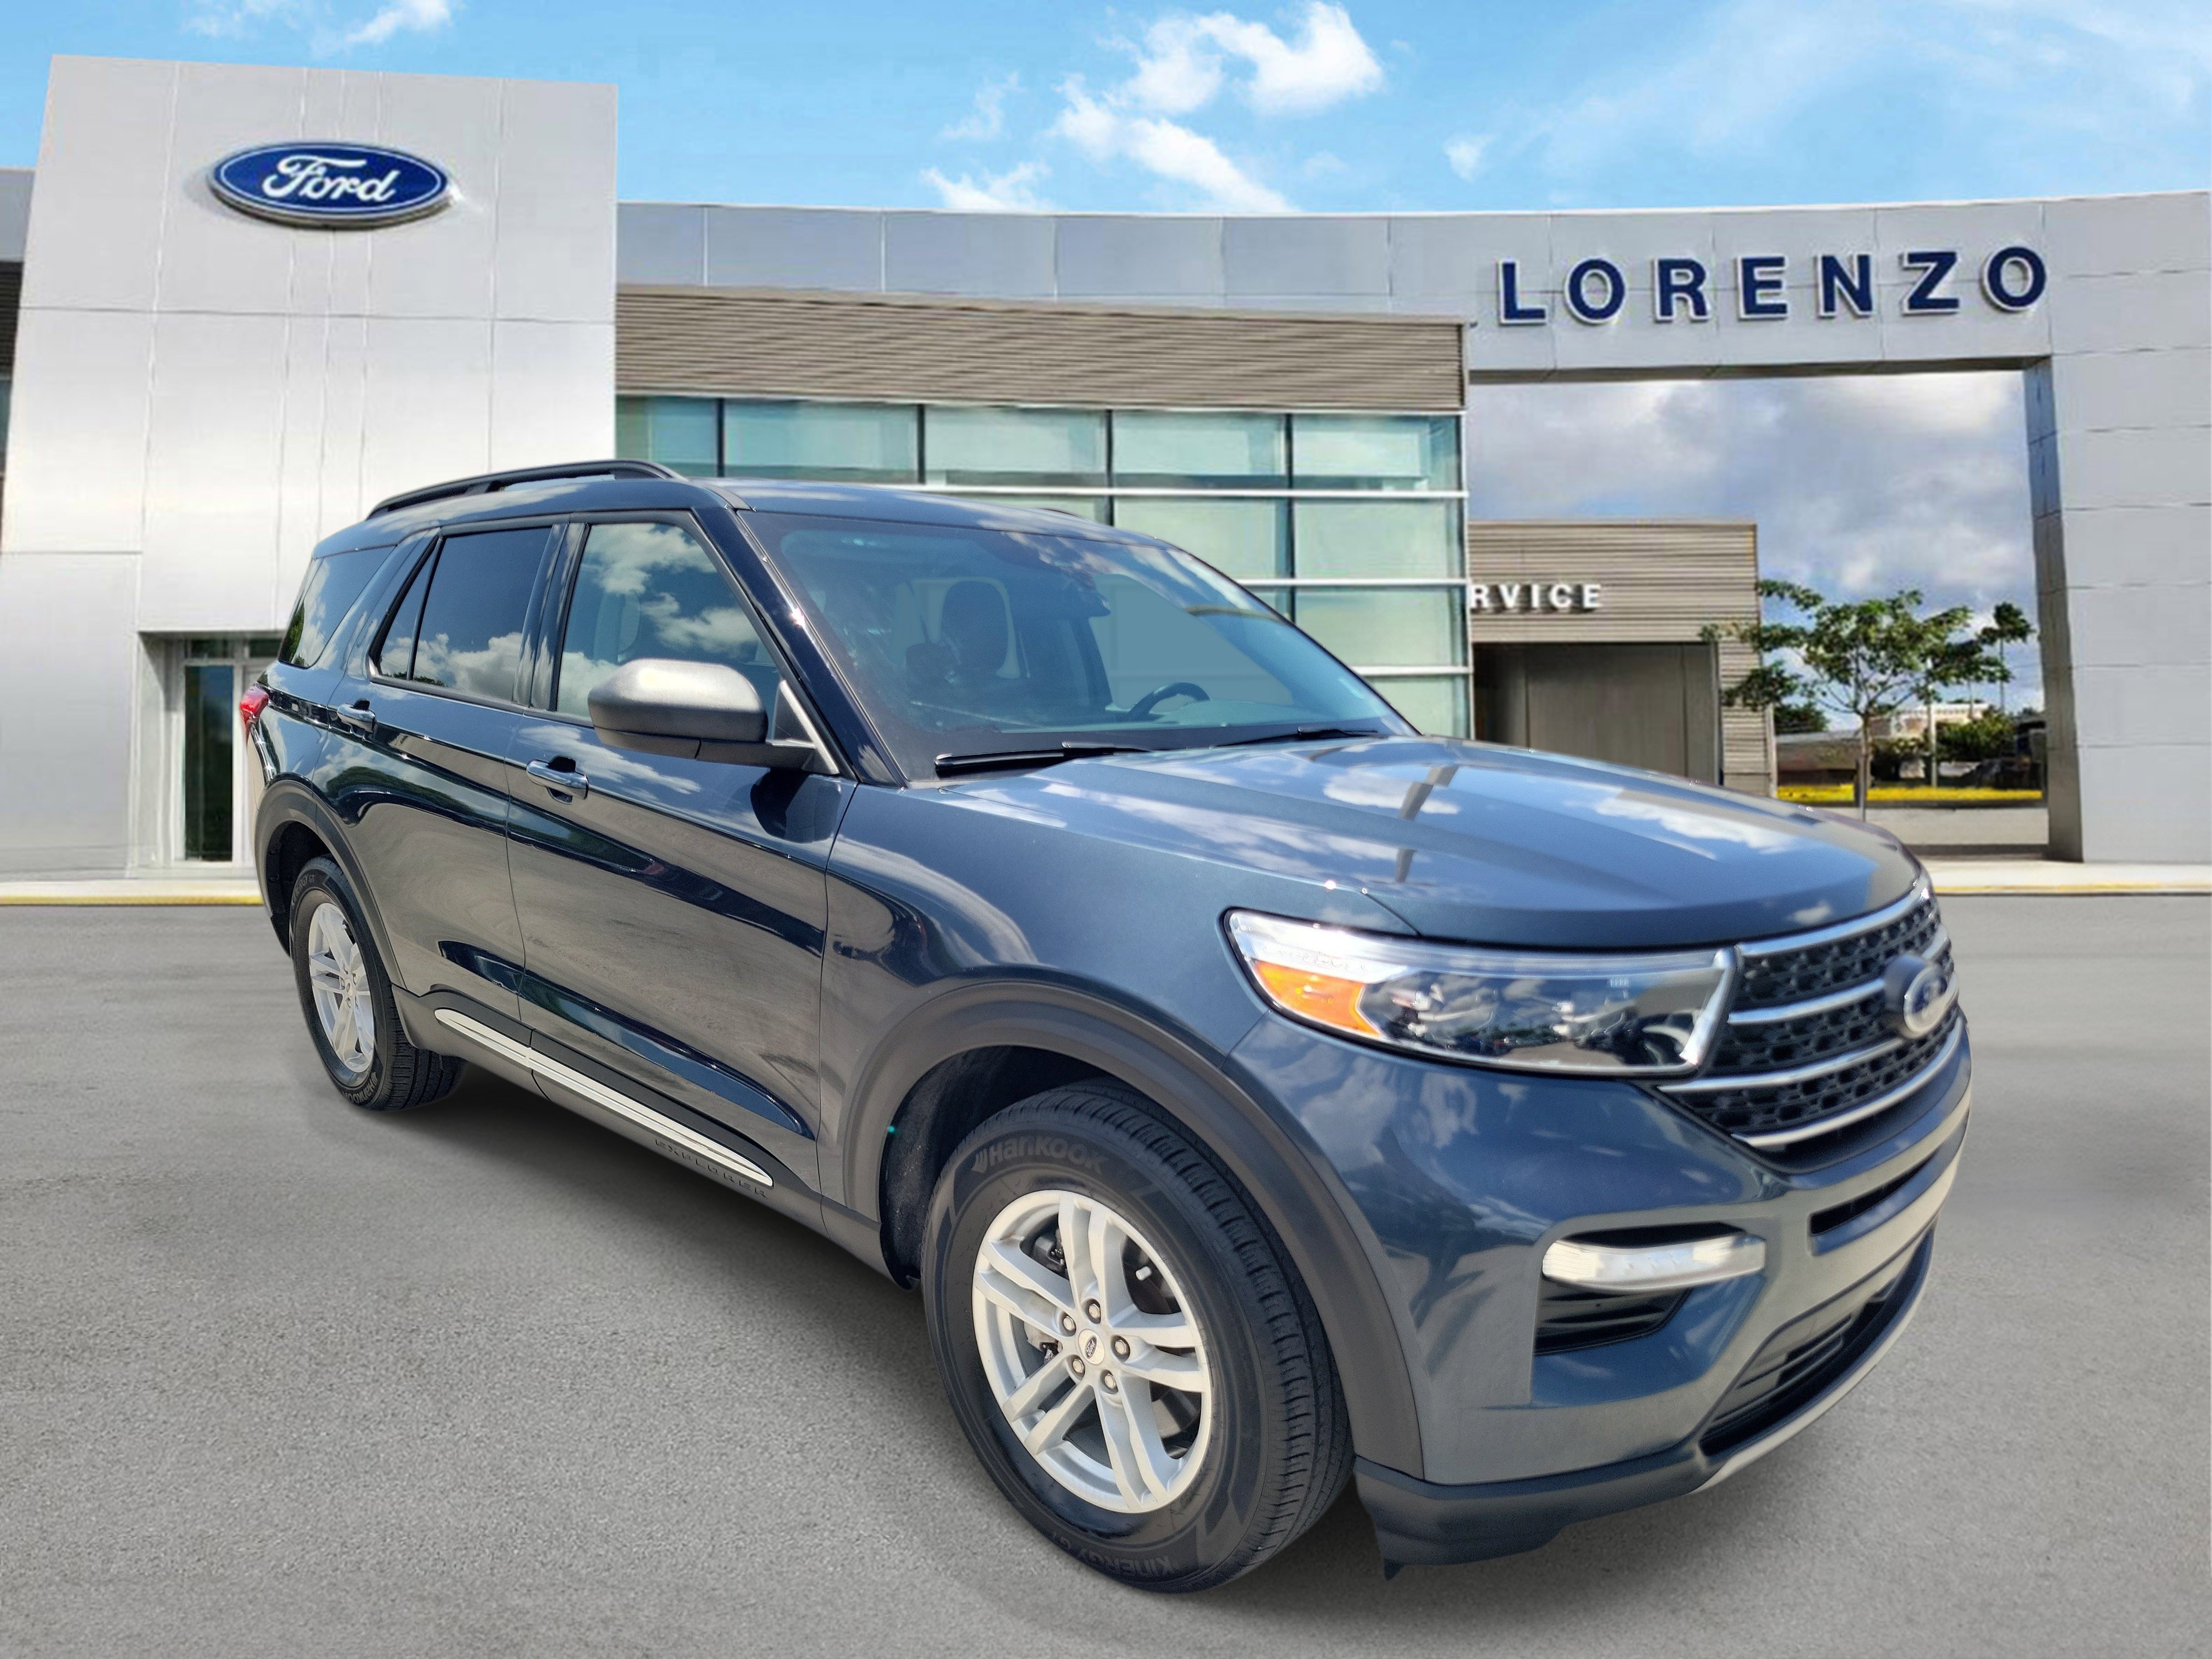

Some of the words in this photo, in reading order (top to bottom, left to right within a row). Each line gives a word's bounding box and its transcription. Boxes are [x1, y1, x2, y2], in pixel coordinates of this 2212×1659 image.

[262, 155, 401, 202] Ford
[1499, 246, 2047, 323] LORENZO
[655, 1139, 766, 1198] EXPLORER
